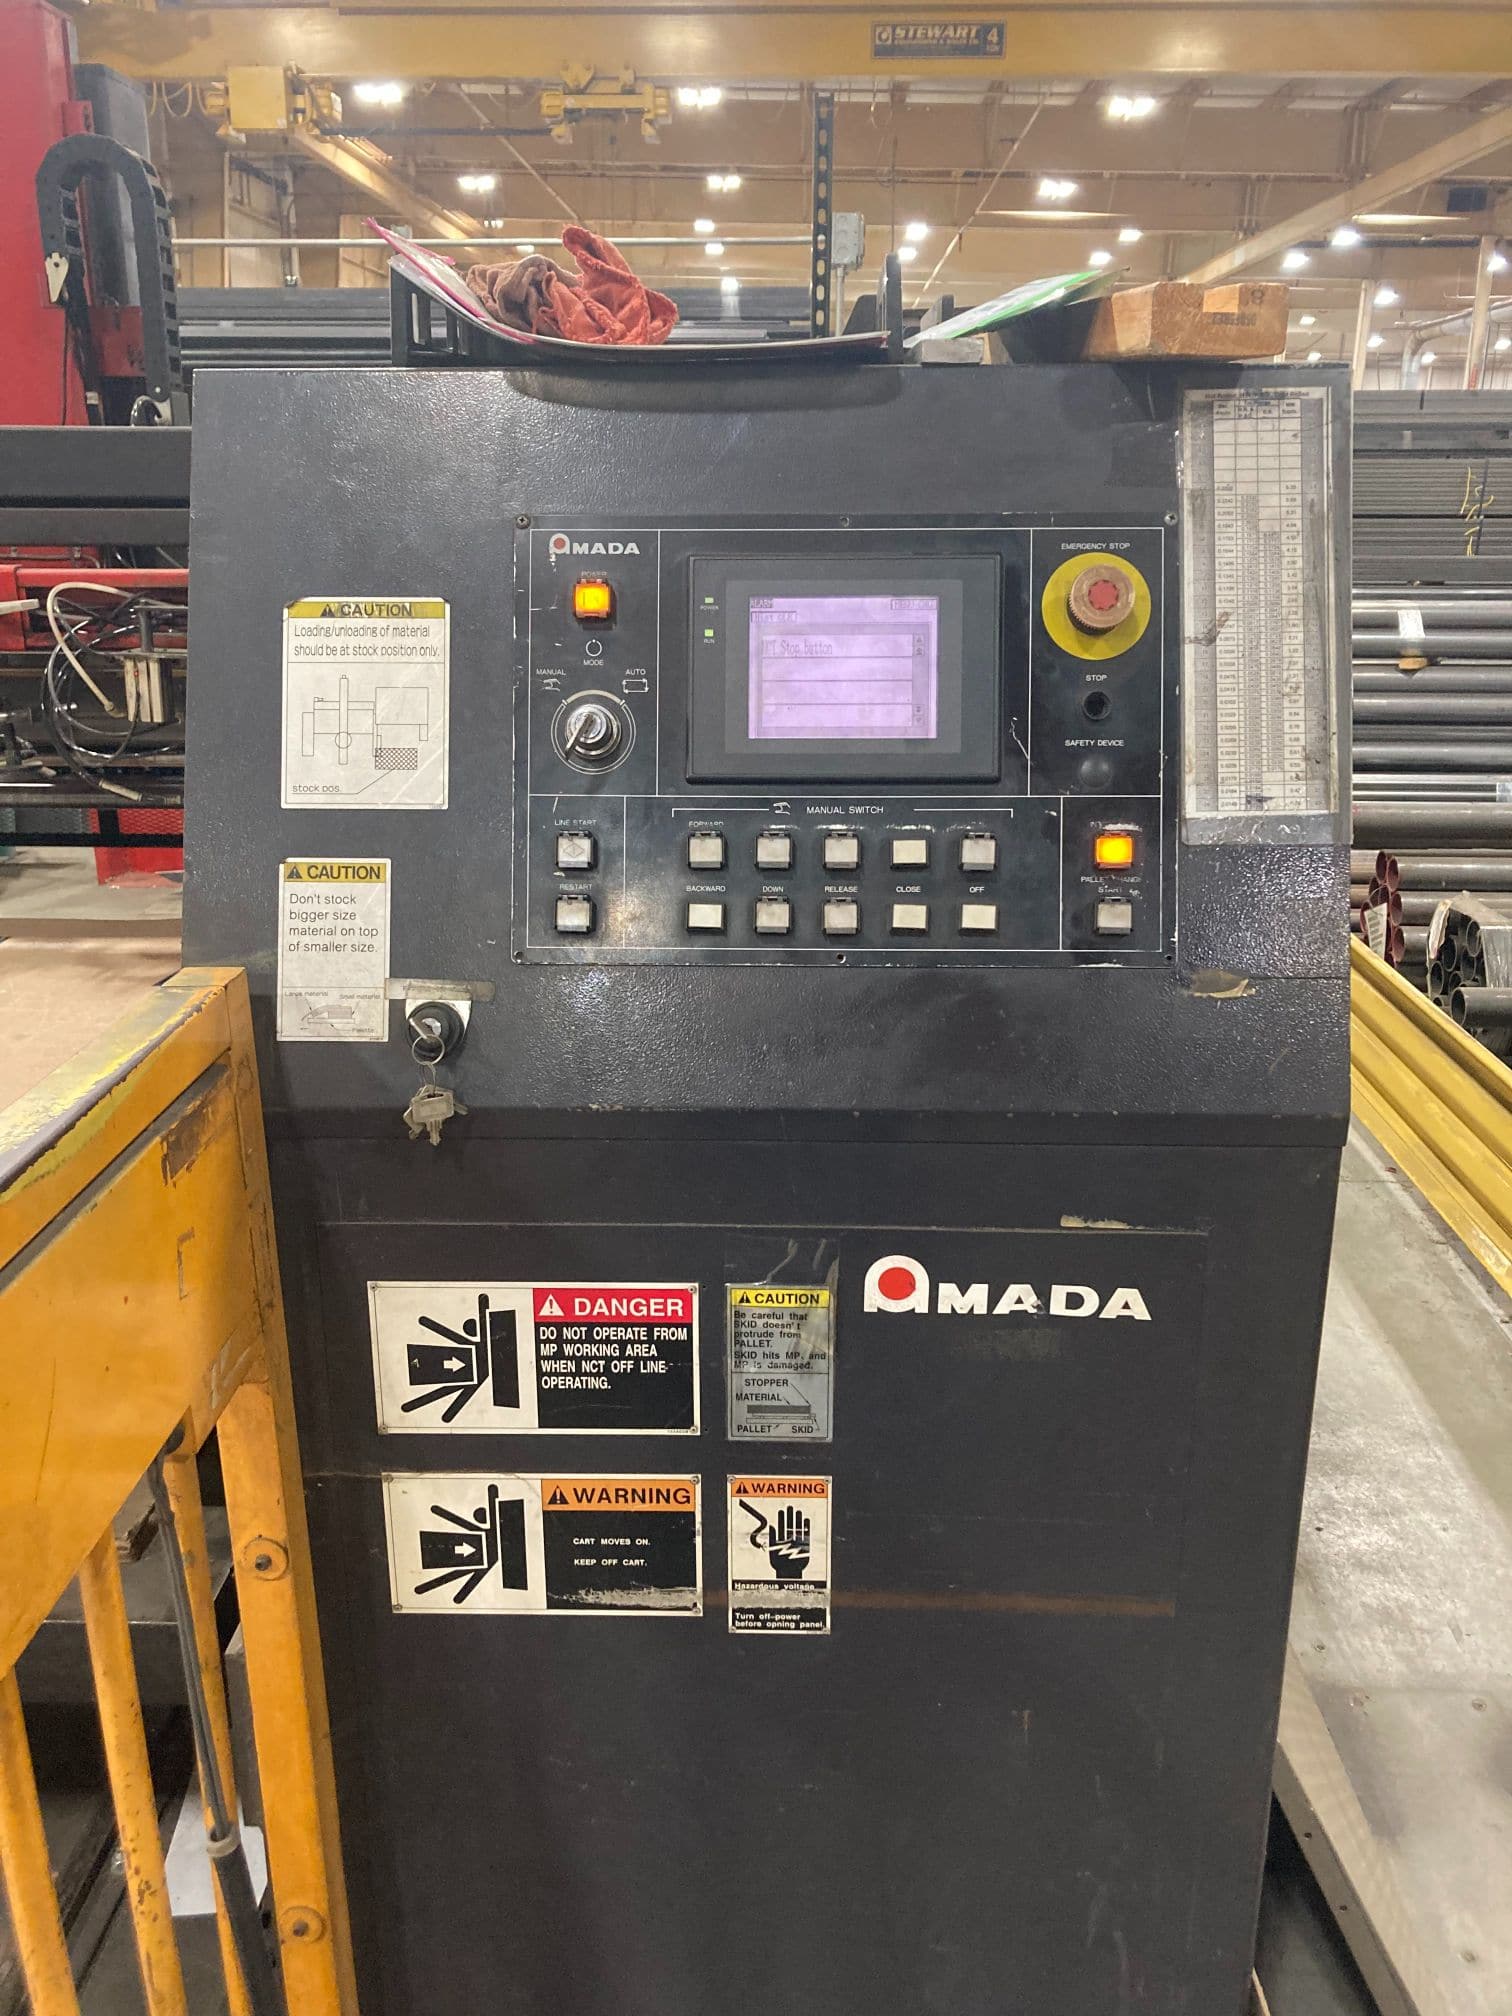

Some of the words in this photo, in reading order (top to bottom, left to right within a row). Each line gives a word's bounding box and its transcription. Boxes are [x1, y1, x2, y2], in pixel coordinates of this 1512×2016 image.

[894, 25, 979, 38] STEWART
[987, 27, 999, 43] 4
[341, 604, 412, 617] CAUTION
[294, 625, 377, 638] Loading/unloading
[380, 625, 391, 637] of
[394, 625, 430, 637] material
[294, 644, 324, 656] should
[326, 644, 337, 656] be
[340, 645, 349, 656] at
[353, 644, 378, 656] stock
[420, 644, 440, 657] only.
[804, 640, 833, 655] button
[536, 668, 566, 676] MANUAL
[292, 784, 320, 792] stock
[807, 806, 845, 814] MANUAL
[848, 806, 884, 814] SWITCH
[307, 865, 380, 880] CAUTION
[289, 893, 320, 904] Don't
[324, 894, 357, 904] stock
[289, 909, 330, 922] bigger
[332, 910, 357, 920] size
[289, 926, 337, 936] material
[340, 928, 356, 936] on
[359, 926, 379, 939] top
[288, 941, 300, 952] of
[303, 941, 348, 952] smaller
[350, 943, 378, 953] size.
[864, 1255, 1152, 1320] AMADA
[754, 1294, 820, 1304] CAUTION
[574, 1297, 684, 1317] DANGER
[734, 1311, 746, 1319] Be
[751, 1312, 784, 1320] careful
[789, 1312, 808, 1320] that
[539, 1327, 557, 1340] DO
[563, 1327, 588, 1340] NOT
[593, 1327, 648, 1340] OPERATE
[654, 1327, 688, 1340] FROM
[734, 1331, 774, 1339] protrude
[780, 1331, 801, 1339] from
[734, 1340, 773, 1348] PALLET.
[540, 1344, 558, 1357] MP
[563, 1344, 619, 1357] WORKING
[625, 1344, 658, 1357] AREA
[734, 1351, 757, 1359] SKID
[763, 1351, 780, 1359] hits
[808, 1352, 826, 1360] and
[540, 1360, 576, 1373] WHEN
[581, 1360, 606, 1373] NCT
[611, 1361, 634, 1373] OFF
[734, 1361, 748, 1369] MP
[753, 1361, 762, 1369] is
[767, 1361, 813, 1371] damaged.
[541, 1376, 612, 1389] OPERATING.
[745, 1379, 789, 1387] STOPPER
[736, 1393, 782, 1402] MATERIAL
[737, 1425, 772, 1433] PALLET
[791, 1426, 814, 1434] SKID
[751, 1483, 825, 1494] WARNING
[573, 1488, 691, 1504] WARNING
[623, 1559, 648, 1567] CART.
[784, 1583, 815, 1591] voltage
